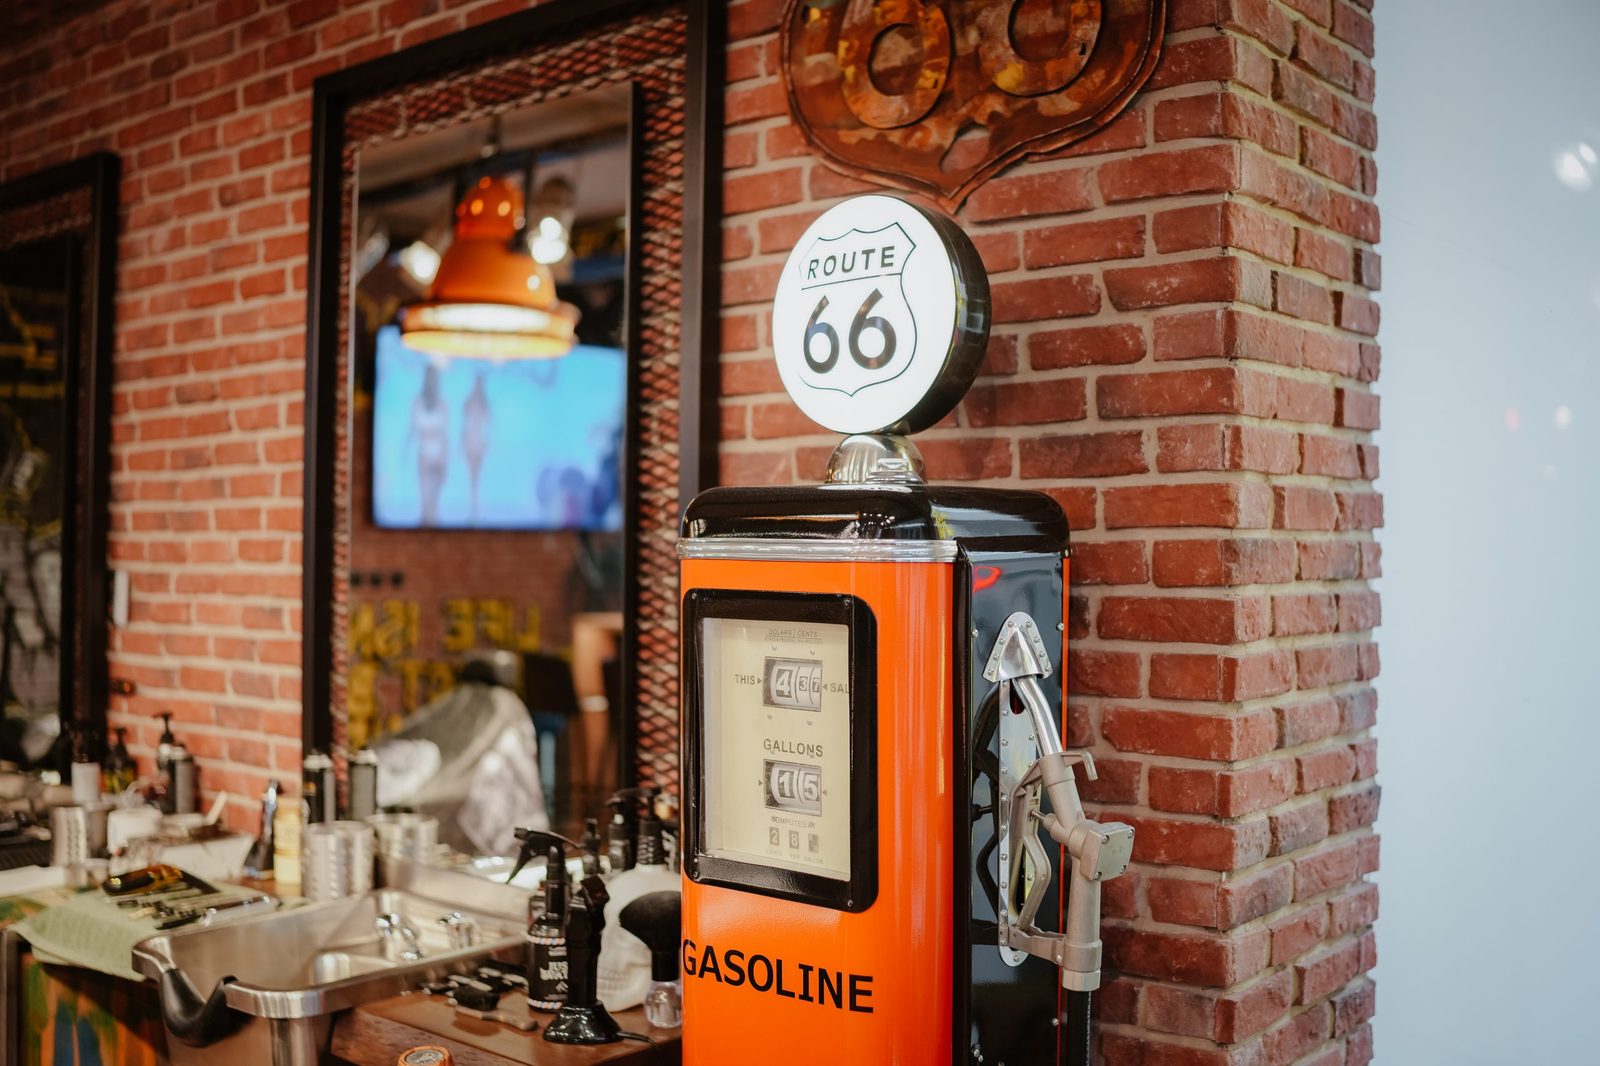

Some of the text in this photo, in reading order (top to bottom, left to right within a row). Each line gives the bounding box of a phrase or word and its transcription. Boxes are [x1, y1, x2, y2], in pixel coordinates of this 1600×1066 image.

[807, 246, 895, 280] ROUTE
[803, 288, 897, 374] 66
[735, 674, 755, 685] THIS
[763, 739, 823, 757] GALLONS
[682, 939, 874, 1014] GASOLINE
